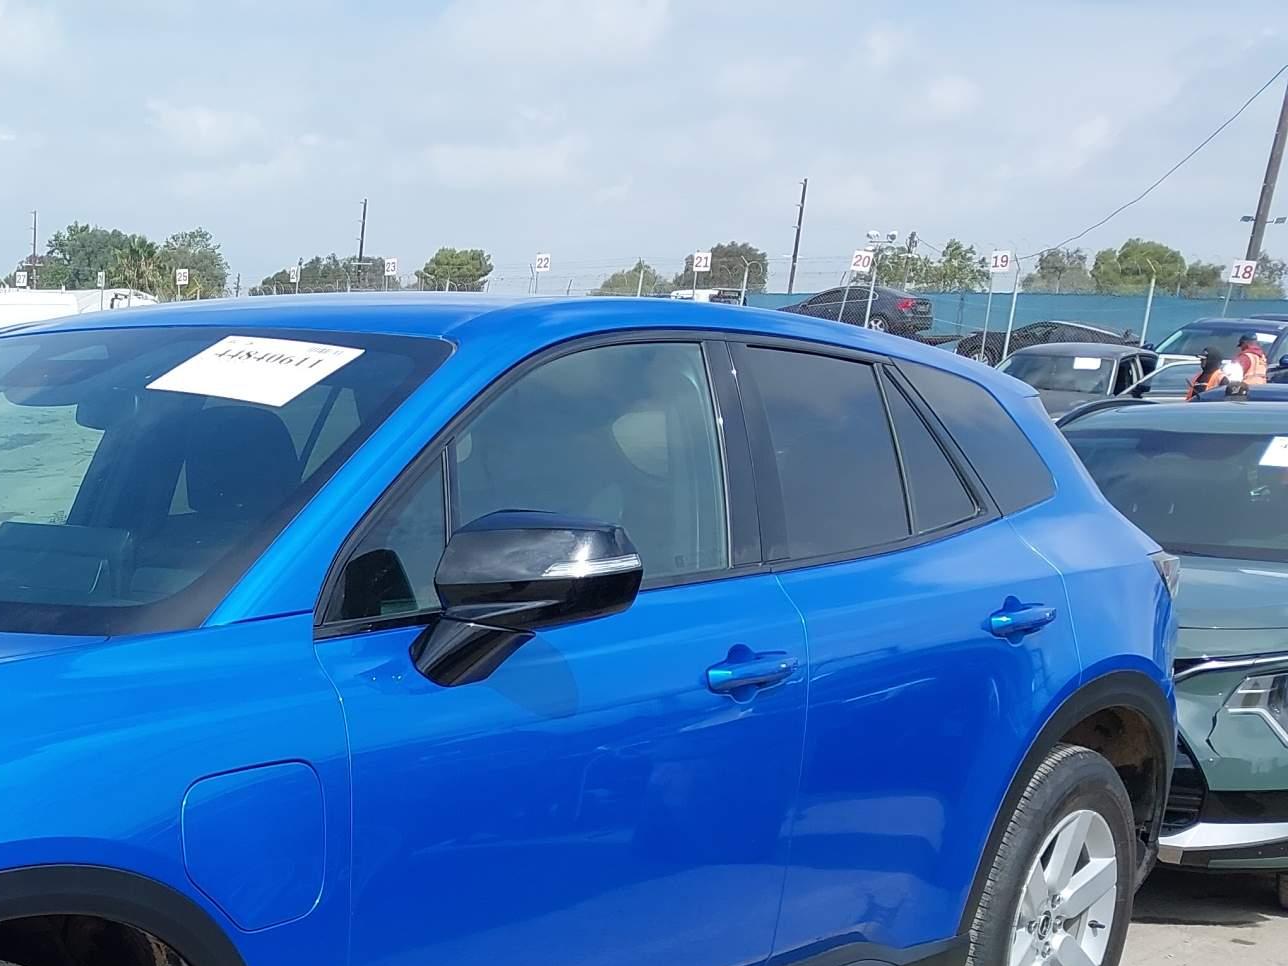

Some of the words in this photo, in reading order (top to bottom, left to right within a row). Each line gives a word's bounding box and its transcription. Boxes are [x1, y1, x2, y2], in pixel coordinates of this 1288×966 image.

[386, 261, 396, 273] 23
[537, 257, 550, 269] 22
[695, 255, 710, 268] 21
[853, 254, 871, 268] 20
[992, 254, 1009, 268] 19
[177, 272, 188, 282] 25
[1231, 264, 1253, 279] 18
[16, 274, 26, 284] 27
[213, 348, 325, 369] 44840611
